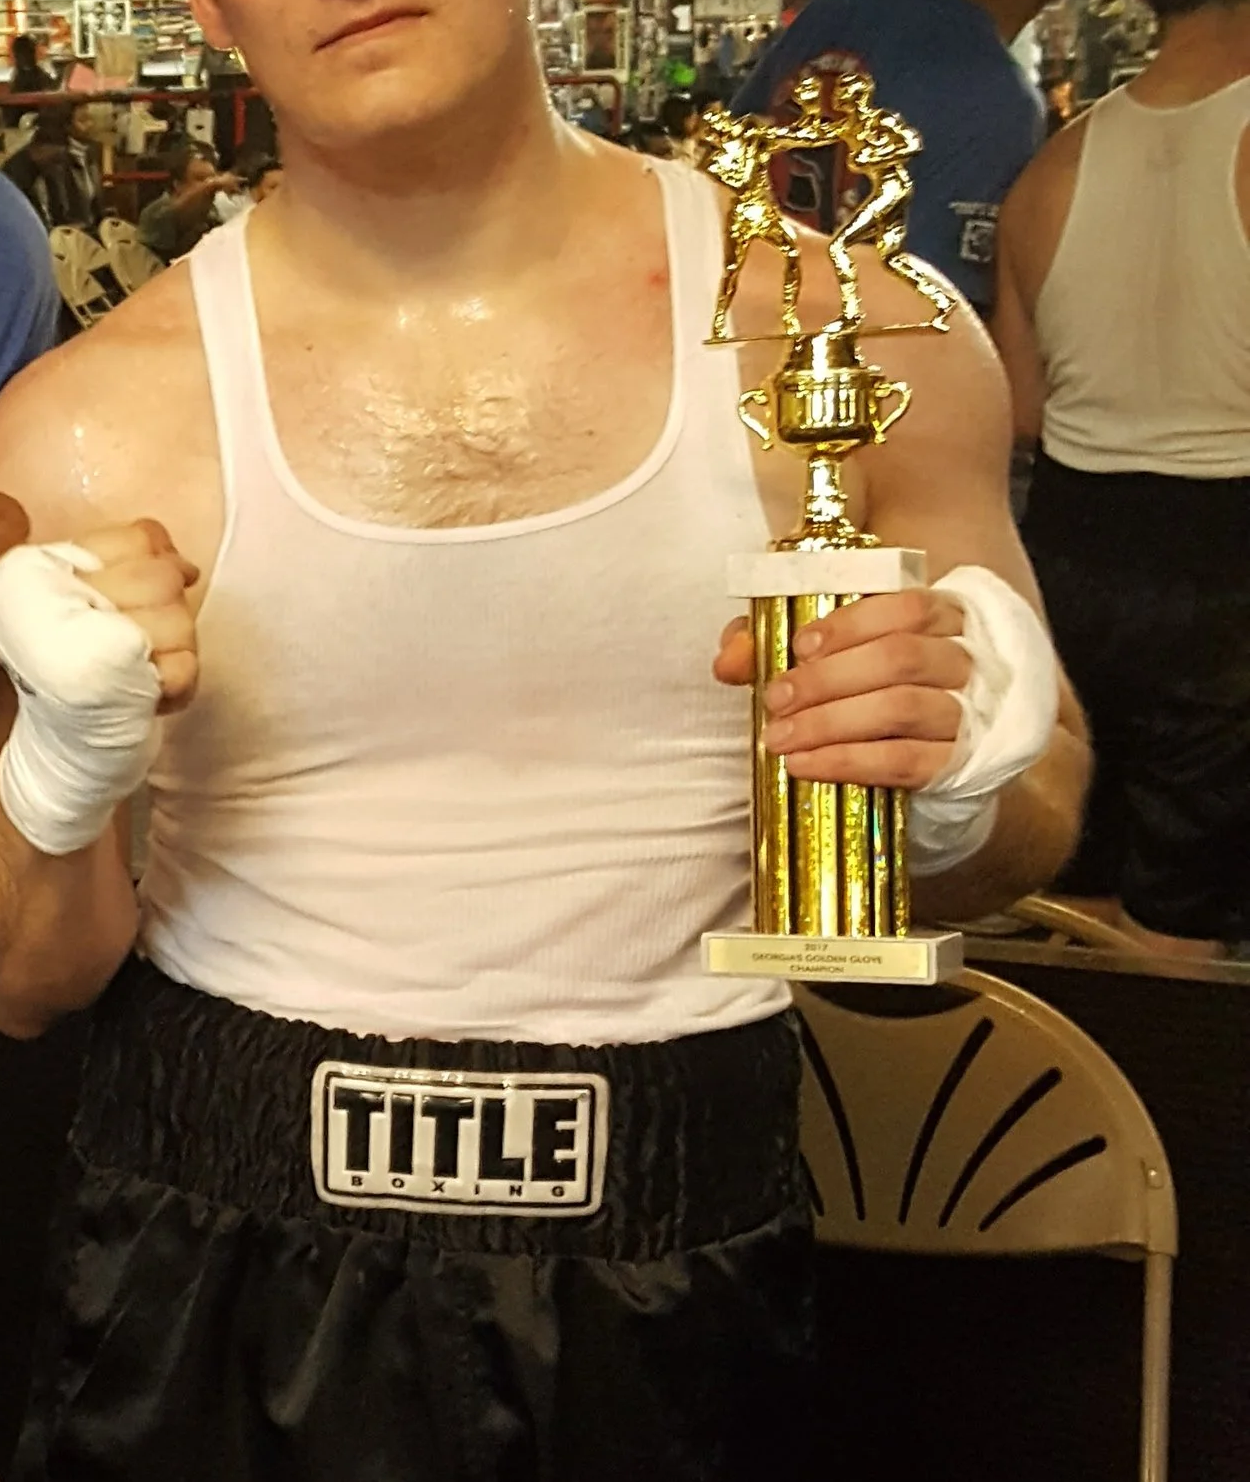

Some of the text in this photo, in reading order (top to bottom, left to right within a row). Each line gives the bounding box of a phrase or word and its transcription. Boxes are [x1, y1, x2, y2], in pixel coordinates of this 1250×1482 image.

[805, 953, 847, 964] GOLDEN
[850, 955, 882, 965] GLOVE
[790, 964, 845, 974] CHAMPION
[333, 1085, 578, 1182] TITLE
[351, 1175, 565, 1198] BOXING
